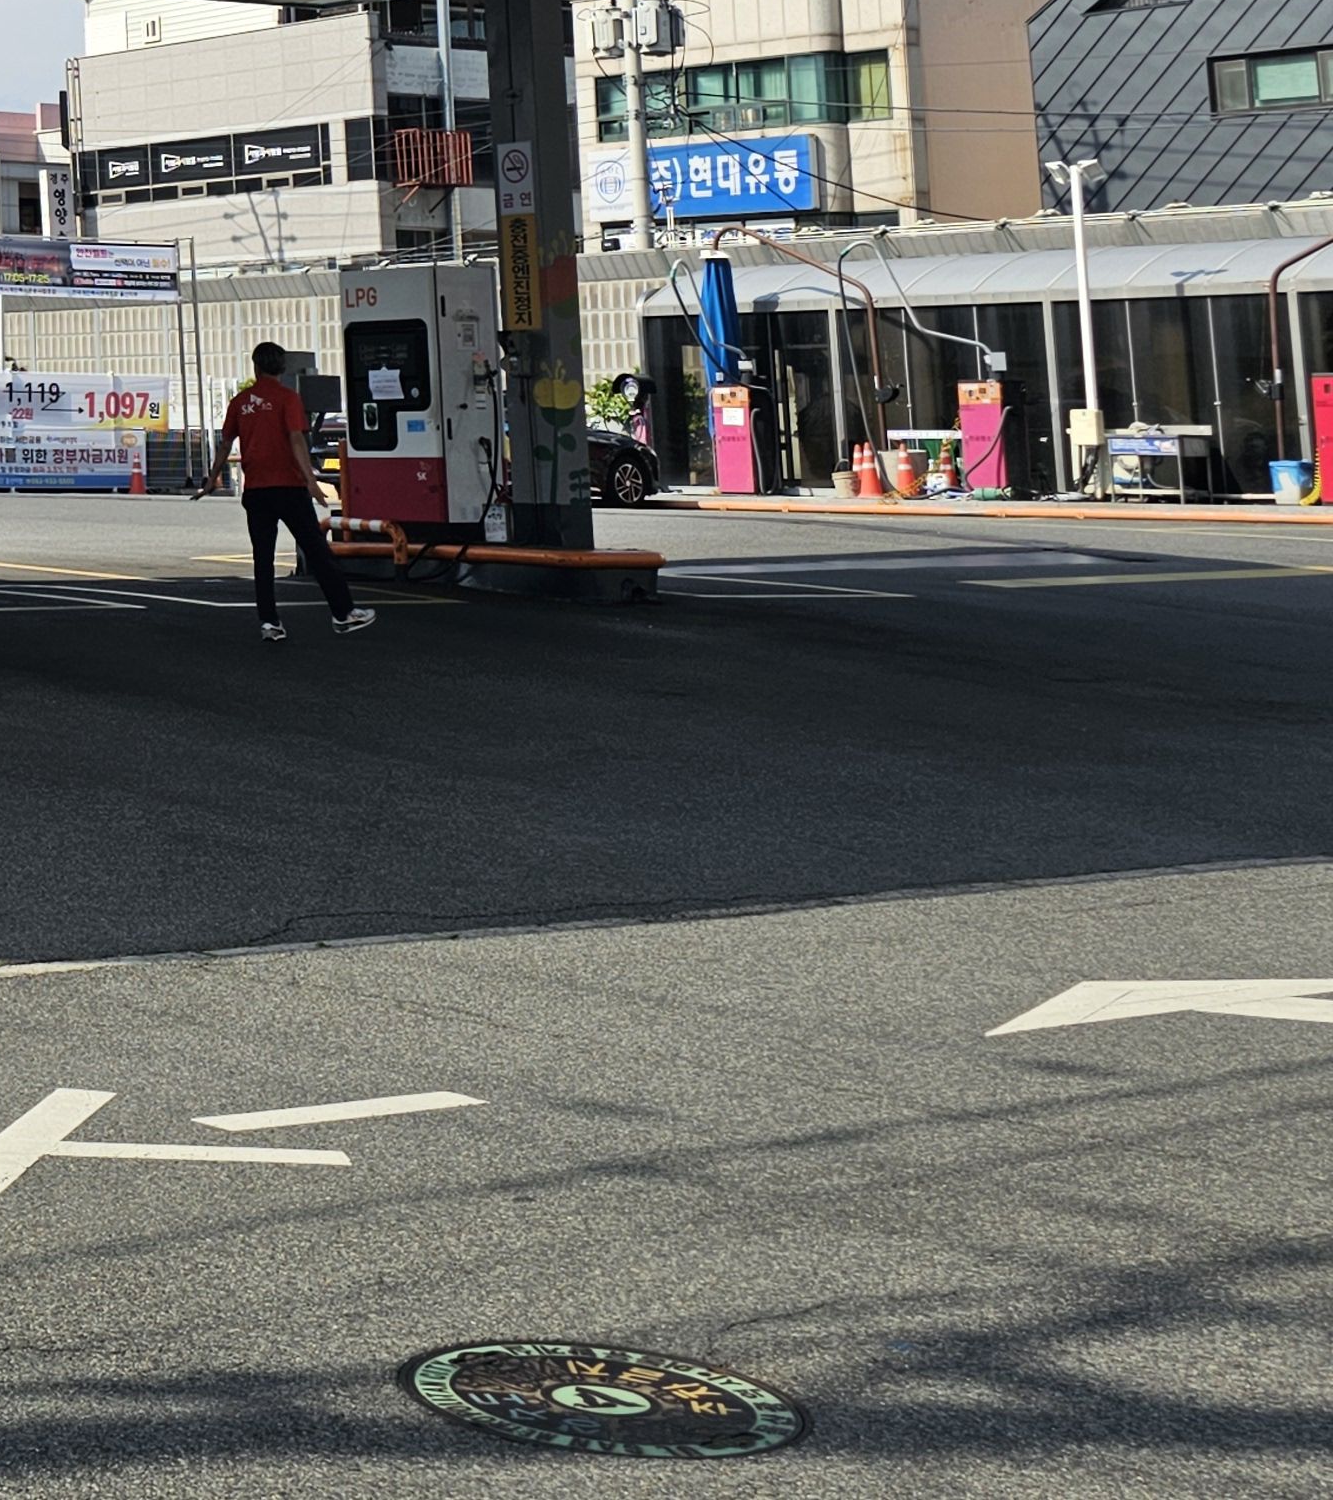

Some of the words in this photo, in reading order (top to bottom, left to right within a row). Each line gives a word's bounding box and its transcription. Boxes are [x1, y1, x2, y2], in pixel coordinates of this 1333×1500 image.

[509, 217, 533, 326] 충전중엔진정지
[345, 287, 377, 309] LPG
[5, 382, 60, 406] 1,119
[22, 448, 47, 464] 위한
[52, 447, 129, 464] 정부자금지원
